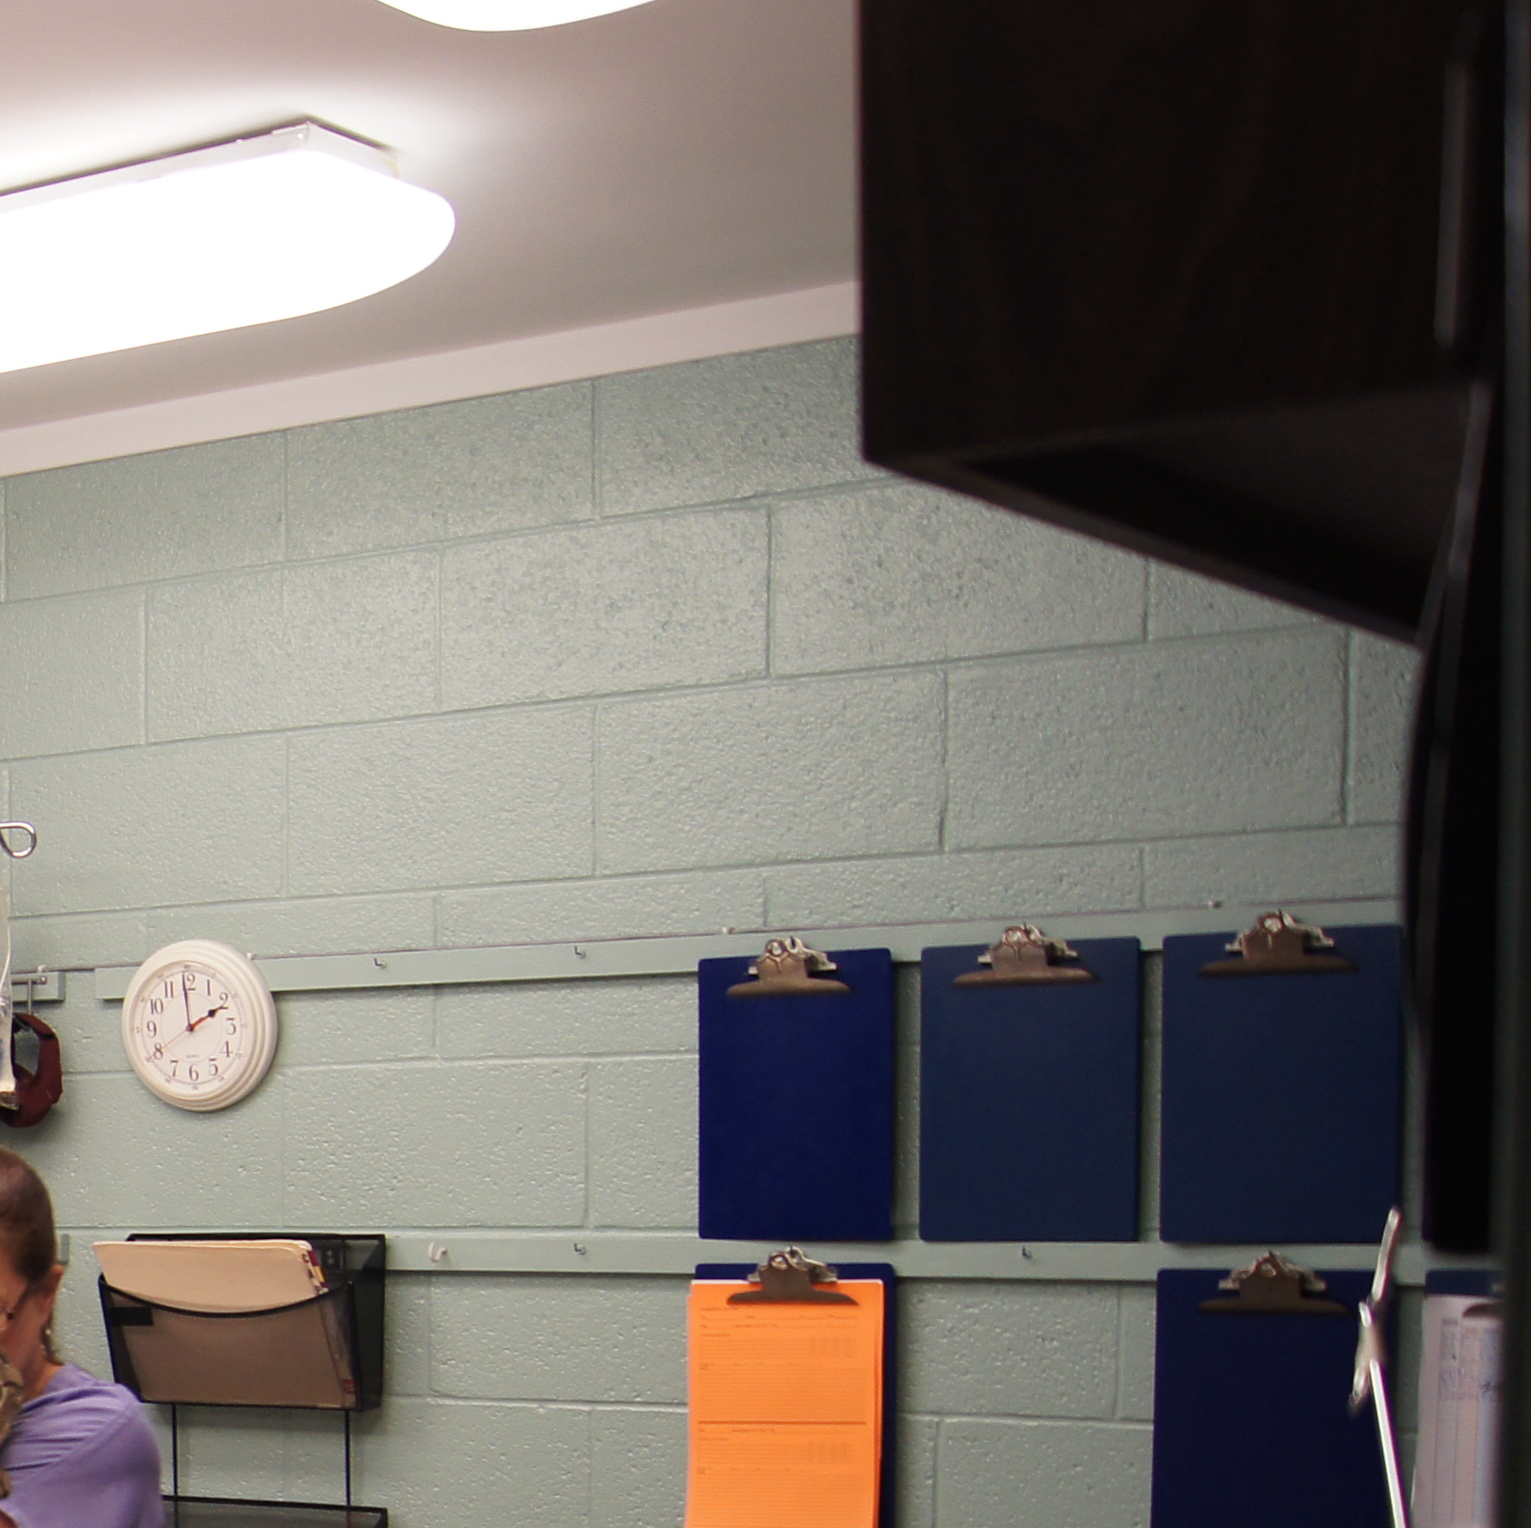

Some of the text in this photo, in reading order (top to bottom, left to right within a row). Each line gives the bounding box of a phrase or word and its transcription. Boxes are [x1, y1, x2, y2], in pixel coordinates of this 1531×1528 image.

[164, 980, 174, 999] 11
[150, 998, 164, 1015] 10
[219, 992, 229, 1010] 2
[146, 1020, 157, 1039] 9
[226, 1017, 237, 1035] 3
[153, 1042, 164, 1060] 8
[220, 1040, 233, 1058] 4
[170, 1060, 179, 1077] 7
[188, 1064, 200, 1082] 6
[209, 1058, 219, 1077] 5
